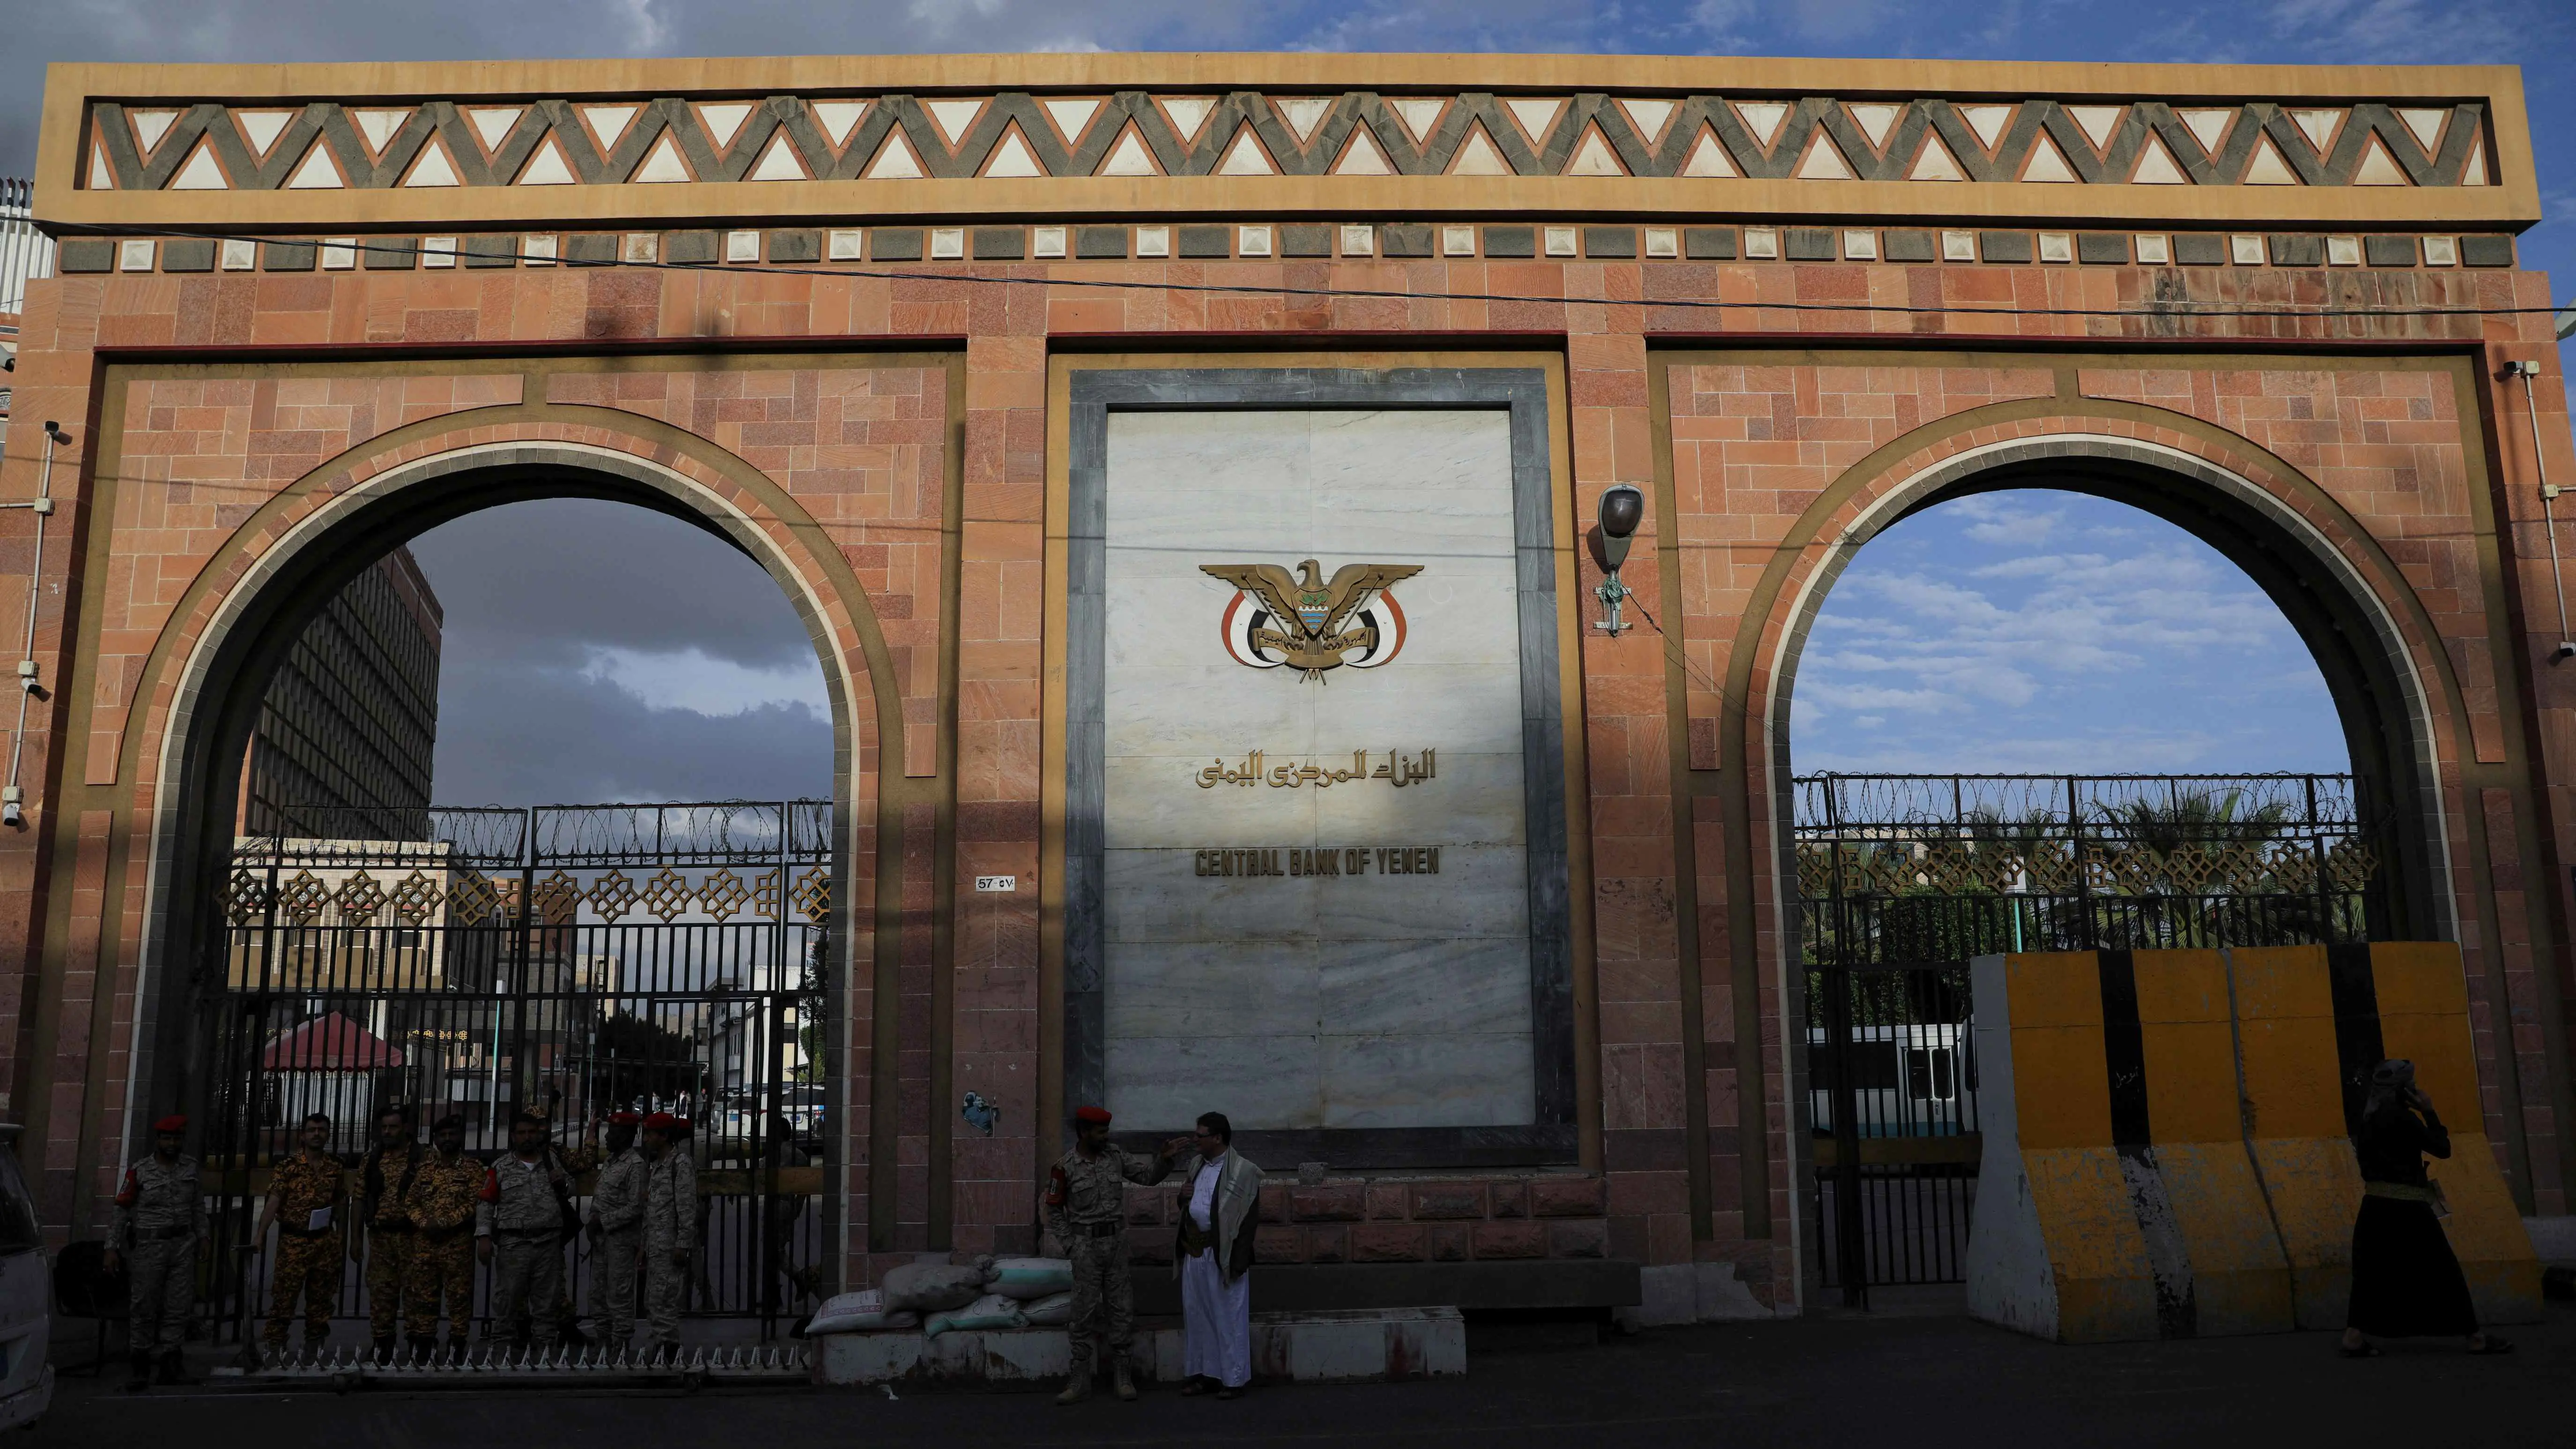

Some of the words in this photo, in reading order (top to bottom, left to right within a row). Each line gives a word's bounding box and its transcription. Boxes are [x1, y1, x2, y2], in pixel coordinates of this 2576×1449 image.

[1371, 747, 1436, 787] البنك
[1195, 849, 1285, 876] CENTRAL
[1289, 849, 1340, 875] BANK
[1345, 848, 1370, 874] OF
[1376, 847, 1439, 874] YEMEN
